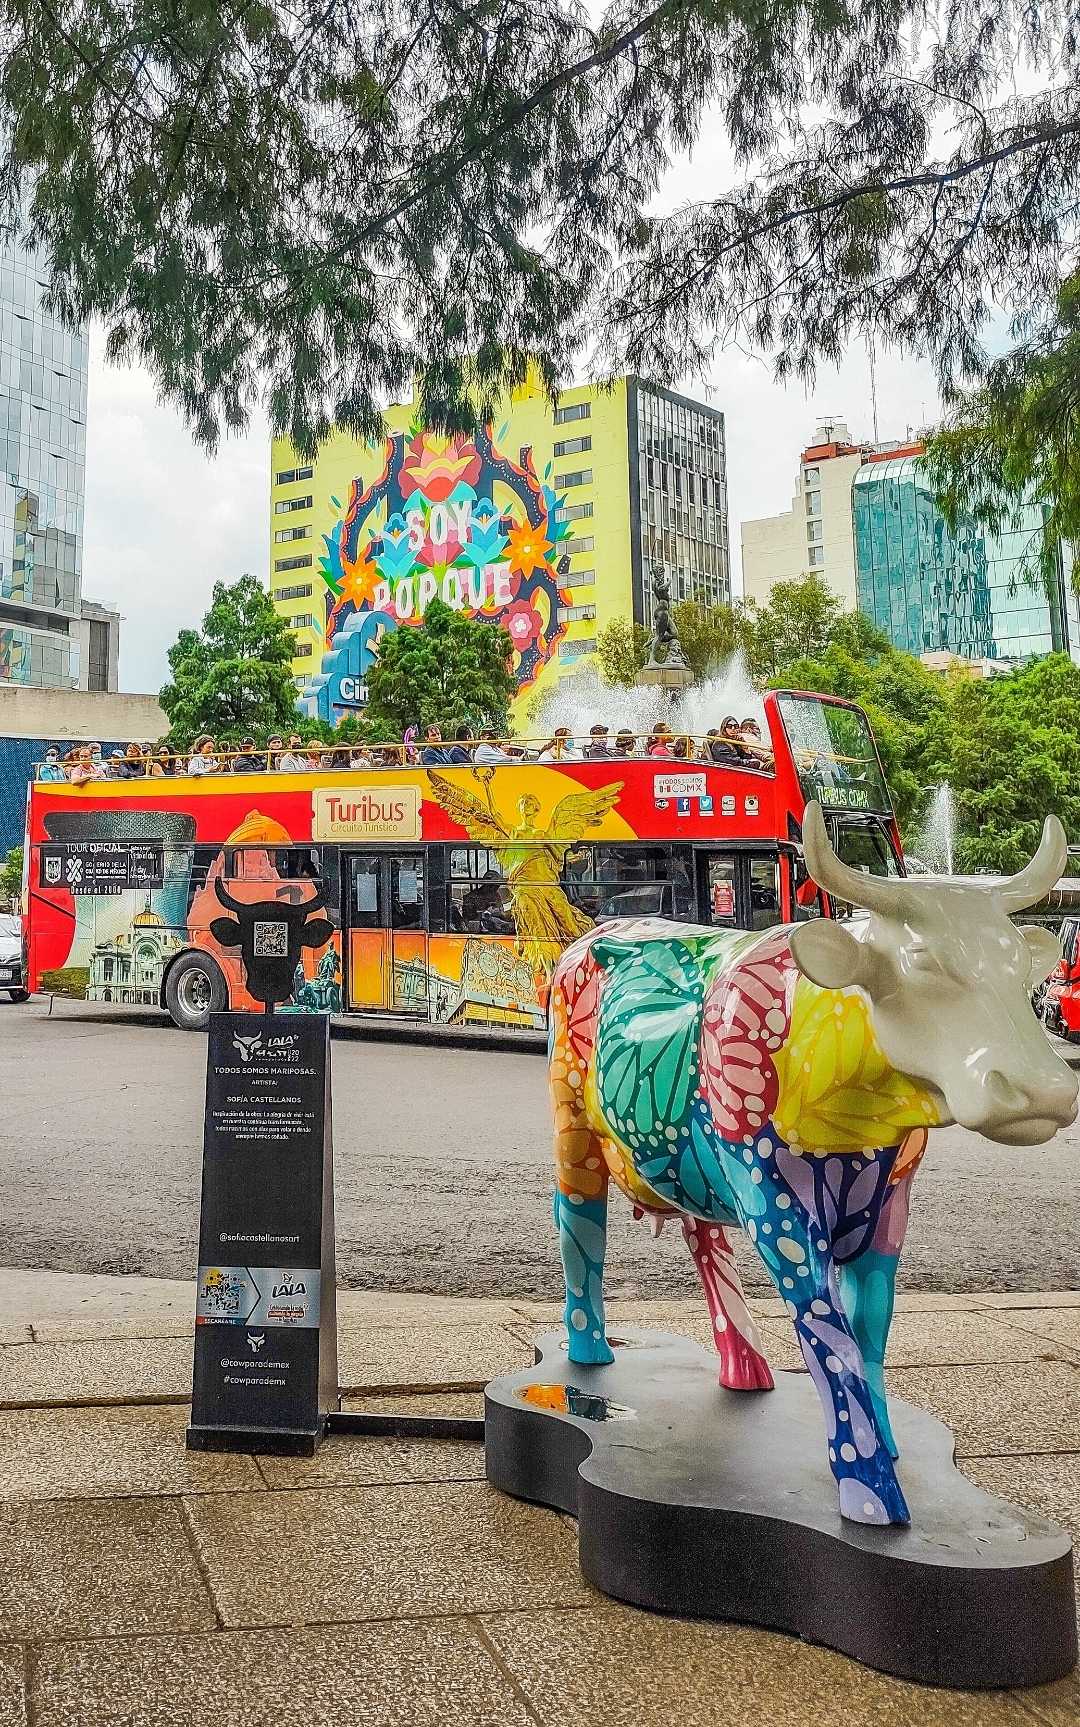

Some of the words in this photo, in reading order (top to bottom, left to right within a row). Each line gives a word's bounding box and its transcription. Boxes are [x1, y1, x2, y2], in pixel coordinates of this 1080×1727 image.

[405, 501, 472, 551] SOY
[672, 783, 703, 793] CDMX
[325, 795, 404, 822] Turibus
[330, 822, 362, 833] Circuito
[65, 843, 89, 853] TOUR
[268, 1035, 294, 1048] LALA
[272, 1282, 307, 1299] LALA
[223, 1375, 286, 1386] #cowparademx
